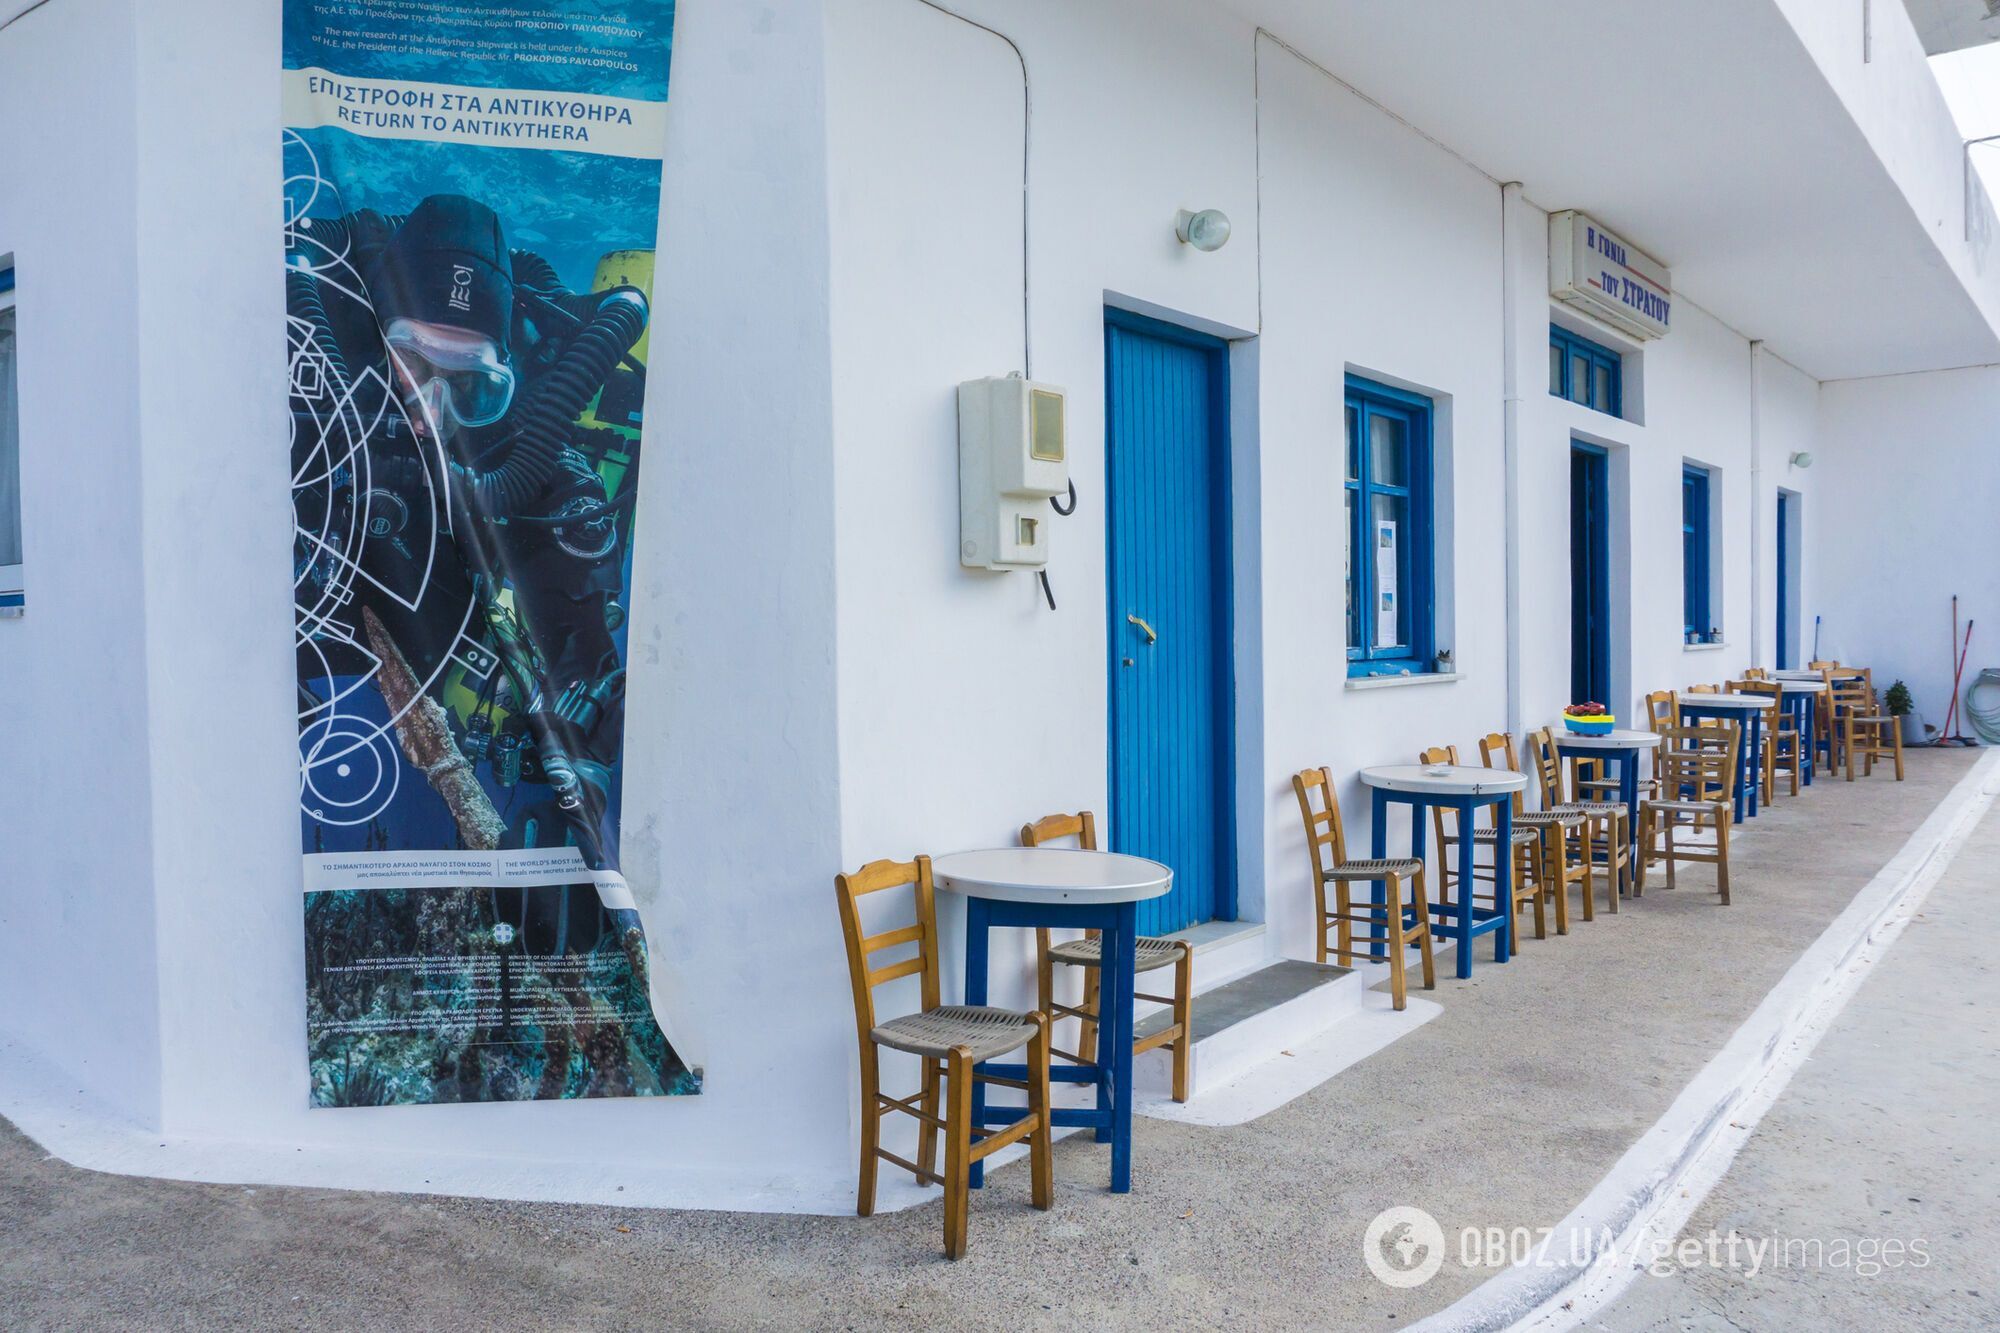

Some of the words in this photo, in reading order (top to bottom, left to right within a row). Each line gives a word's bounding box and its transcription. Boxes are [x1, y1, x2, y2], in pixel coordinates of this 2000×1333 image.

[314, 5, 328, 14] της
[349, 8, 364, 16] του
[366, 8, 409, 20] Προέδρου
[411, 14, 425, 23] της
[427, 14, 482, 28] Δημοκρατίας
[484, 19, 513, 29] Κυρίου
[515, 20, 569, 31] ΠΡΟΚΟΠΙΟΥ
[572, 23, 644, 39] ΠΑΥΛΟΠΟΥΛΟΥ
[312, 34, 321, 43] of
[322, 38, 340, 48] H.E.
[342, 40, 356, 50] the
[358, 42, 397, 52] President
[399, 45, 408, 53] of
[410, 45, 423, 54] the
[425, 47, 458, 58] Hellenic
[460, 50, 498, 61] Republic
[499, 53, 512, 61] Mr.
[514, 53, 568, 65] PROKOPIOS
[569, 57, 639, 72] PAVLOPOULOS
[325, 26, 341, 36] The
[361, 30, 397, 41] research
[410, 34, 424, 42] the
[425, 34, 475, 48] Antikythera
[476, 40, 518, 51] Shipwreck
[520, 42, 527, 50] is
[528, 42, 547, 51] held
[548, 43, 574, 53] under
[574, 44, 589, 54] the
[590, 46, 628, 59] Auspices
[308, 76, 434, 109] ΕΠΙΣΤΡΟΦΗ
[441, 93, 482, 113] ΣΤΑ
[487, 97, 633, 126] ΑΝΤΙΚΥΘΗΡΑ
[338, 106, 415, 129] RETURN
[423, 115, 447, 132] TO
[452, 118, 590, 142] ANTIKYTHERA
[1587, 226, 1595, 249] Η
[1598, 233, 1627, 268] ΓΩΝΙΑ
[1601, 270, 1619, 298] ΤΟΥ
[1622, 276, 1670, 326] ΣΤΡΑΤΟΥ
[333, 862, 392, 870] ΣΗΜΑΝΤΙΚΟΤΕΡΟ
[419, 861, 448, 869] ΝΑΥΑΓΙΟ
[505, 868, 528, 876] reveals
[543, 867, 565, 875] secrets
[551, 858, 570, 866] MOST
